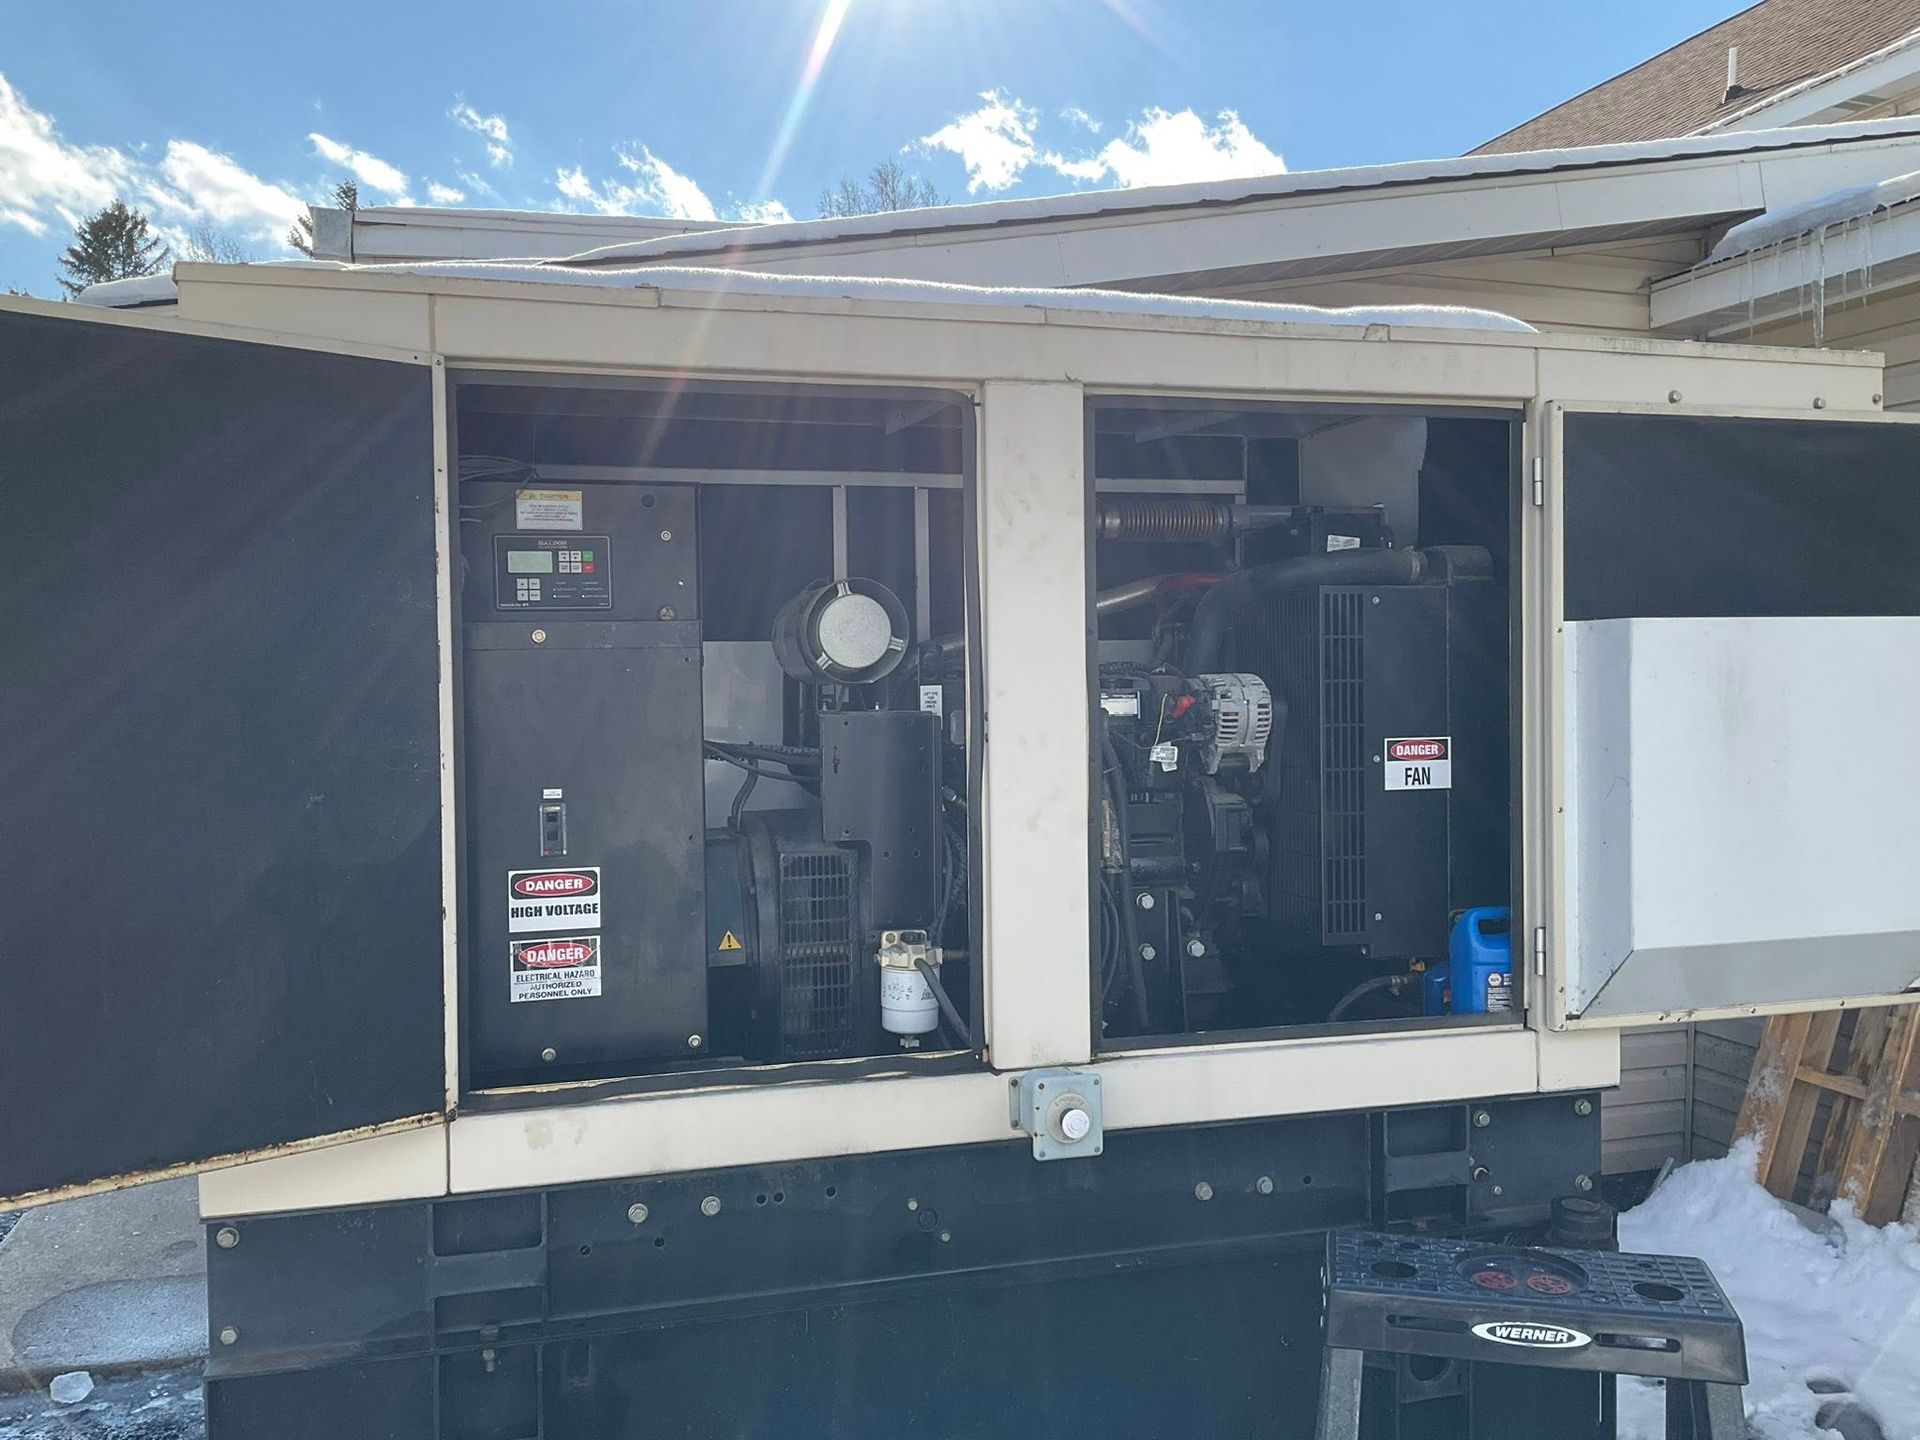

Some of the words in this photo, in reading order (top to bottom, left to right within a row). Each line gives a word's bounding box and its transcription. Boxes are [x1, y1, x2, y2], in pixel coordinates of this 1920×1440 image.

[1396, 744, 1439, 756] DANGER
[1404, 766, 1431, 786] FAN
[526, 879, 583, 892] DANGER
[511, 906, 542, 918] HIGH
[545, 903, 598, 916] VOLTAGE
[527, 948, 584, 962] DANGER
[516, 972, 561, 982] ELECTRICAL
[564, 970, 595, 980] HAZARD
[530, 981, 582, 991] AUTHORIZED
[519, 990, 570, 999] PERSONNEL
[571, 988, 592, 997] ONLY
[1495, 1326, 1569, 1342] WERNER
